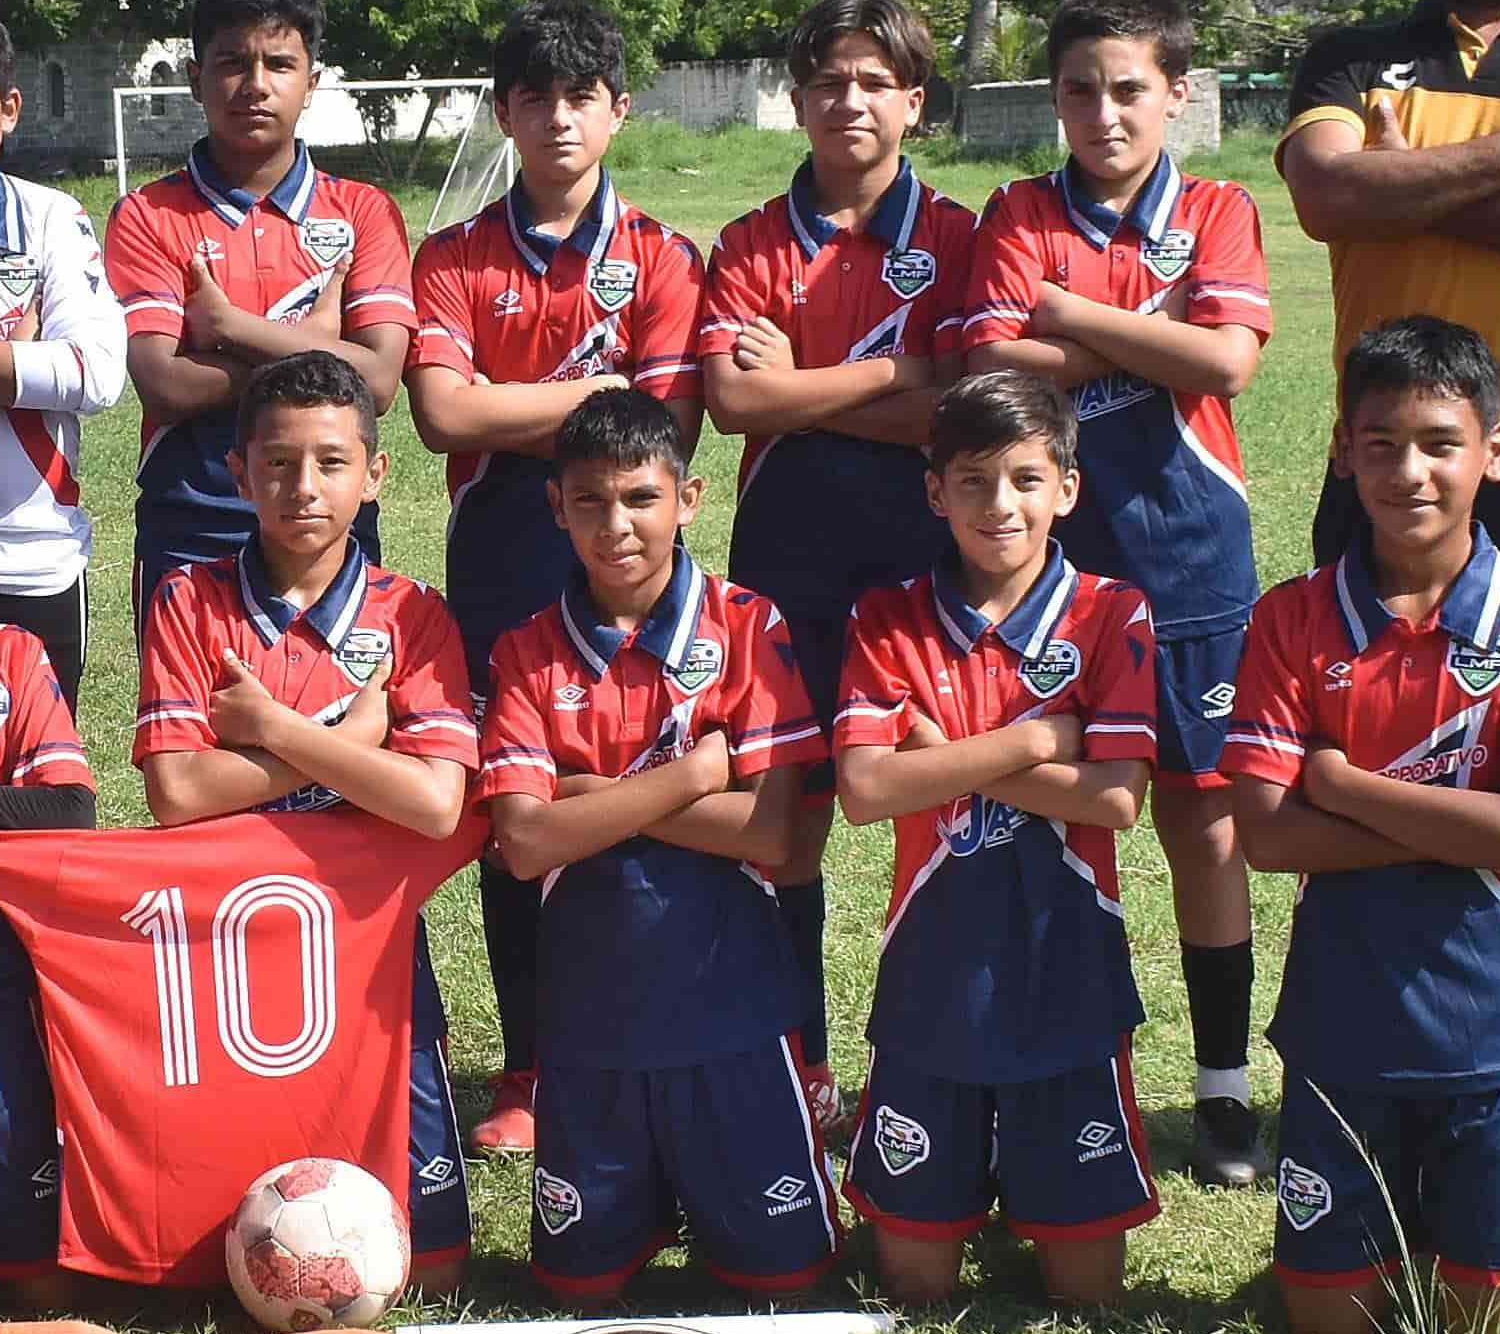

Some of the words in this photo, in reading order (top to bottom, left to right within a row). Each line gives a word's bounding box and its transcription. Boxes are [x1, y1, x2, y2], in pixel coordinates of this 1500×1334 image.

[1146, 249, 1190, 261] LMF
[889, 268, 928, 279] LMF
[1025, 662, 1073, 674] LMF
[120, 874, 337, 1086] 10
[879, 1136, 923, 1156] LMF
[1079, 1142, 1122, 1163] UMBRO
[767, 1196, 812, 1217] UMBRO
[1283, 1189, 1323, 1207] LMF
